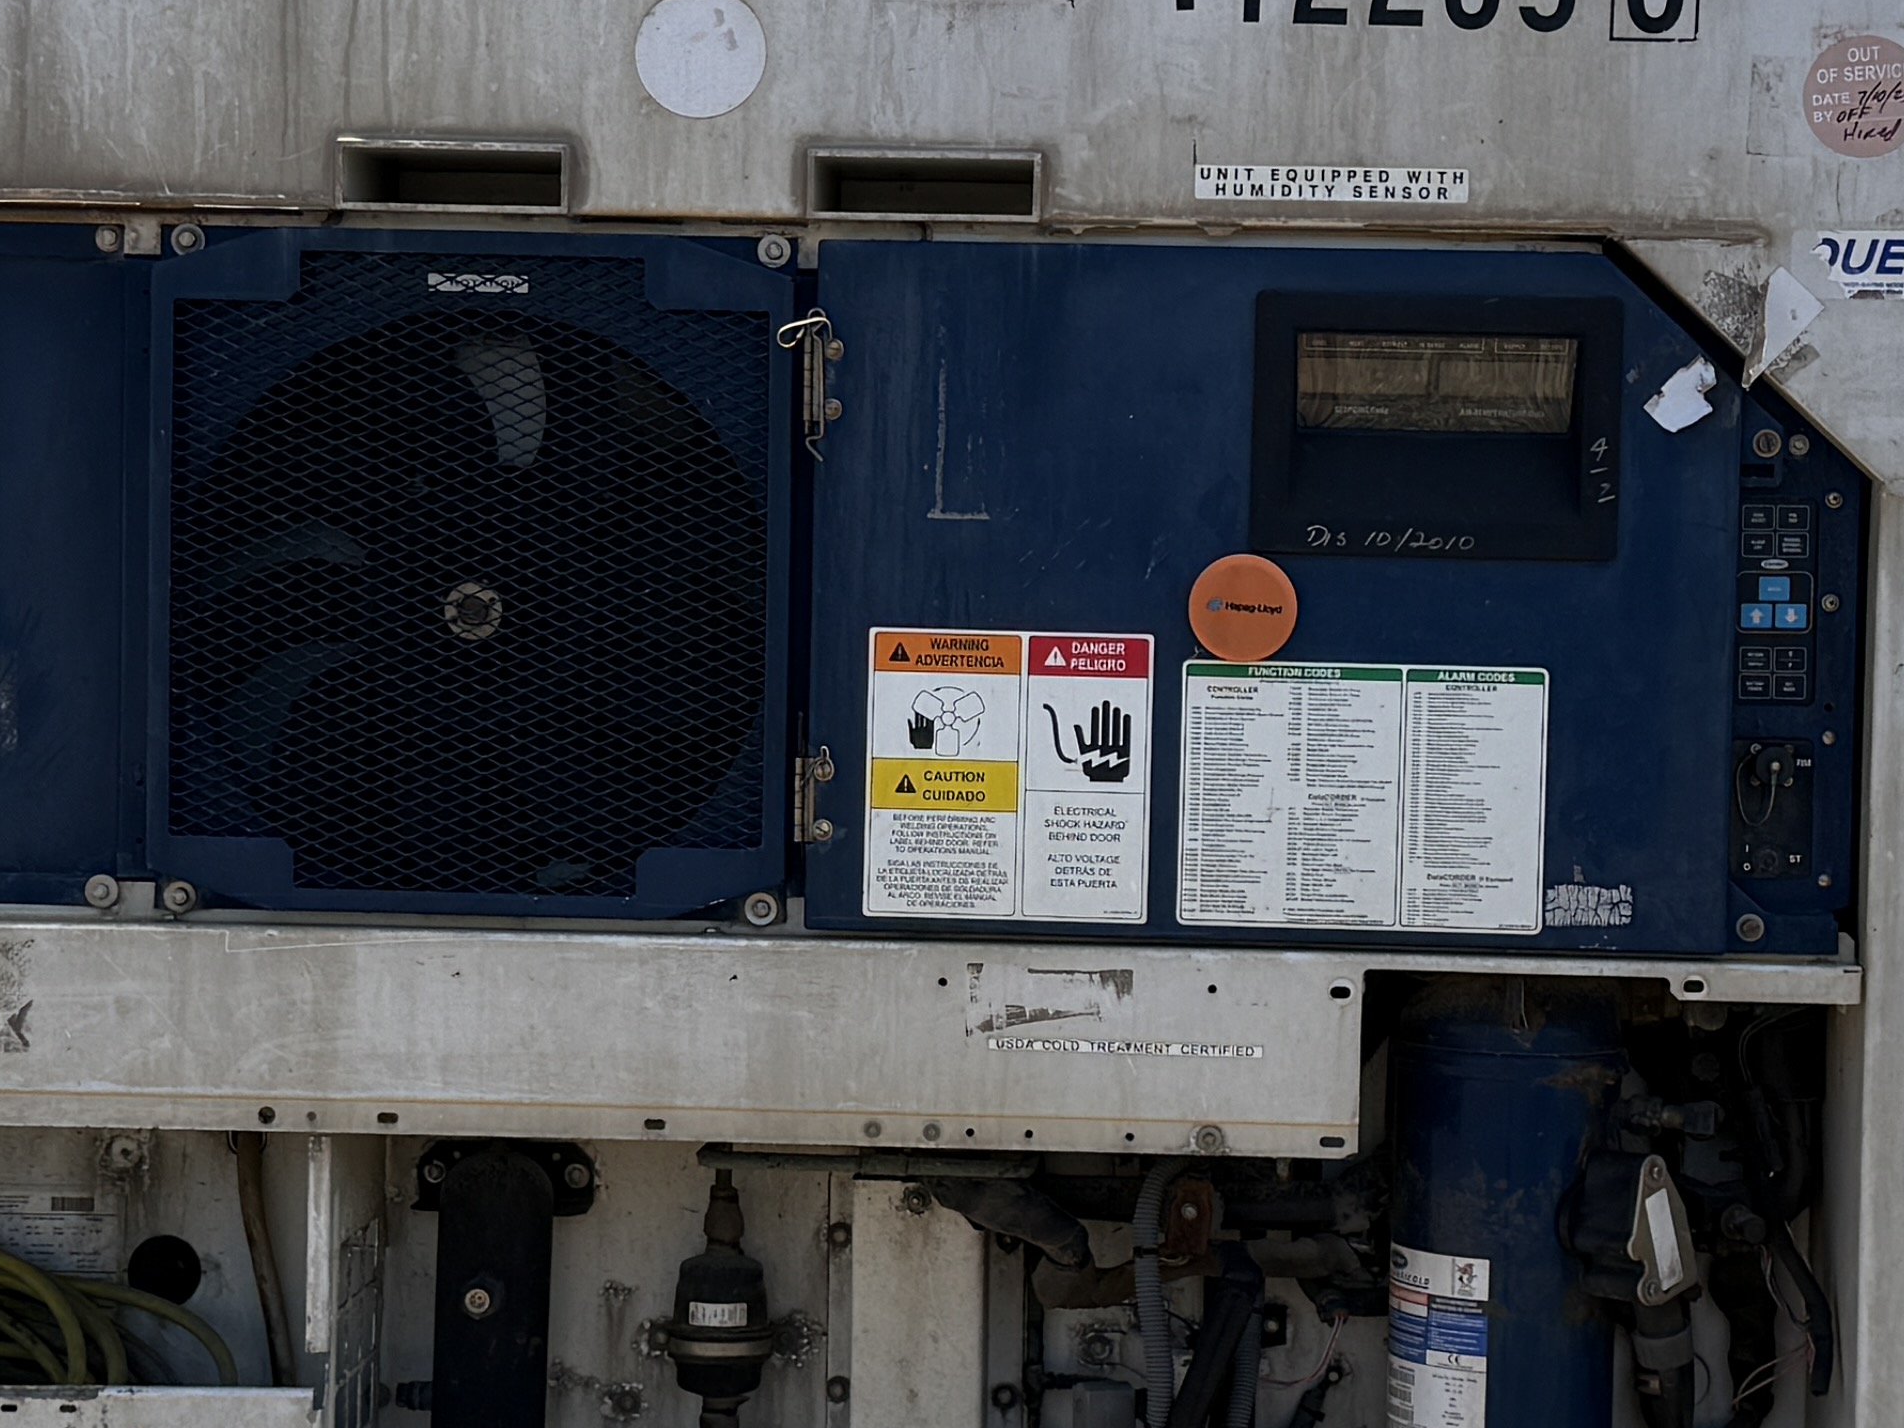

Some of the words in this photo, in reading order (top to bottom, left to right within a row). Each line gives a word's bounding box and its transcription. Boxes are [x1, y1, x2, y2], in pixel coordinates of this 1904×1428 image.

[1847, 46, 1880, 62] OUT
[1816, 68, 1838, 84] OF
[1812, 92, 1851, 106] DATE
[1813, 111, 1833, 122] BY
[1200, 167, 1254, 181] UNIT
[1271, 168, 1390, 183] EQUIPPED
[1406, 170, 1464, 184] WITH
[1216, 183, 1336, 198] HUMIDITY
[1352, 185, 1448, 200] SENSOR
[1225, 601, 1282, 614] Hapag-Lloyd
[930, 638, 990, 652] WARNING
[1072, 642, 1125, 655] DANGER
[915, 654, 1004, 669] ADVERTENCIA
[1070, 658, 1126, 672] PELIGRO
[1248, 667, 1302, 677] FUNCTION
[1303, 668, 1341, 678] CODES
[1437, 671, 1476, 681] ALARM
[1477, 672, 1515, 682] CODES
[1207, 685, 1259, 693] CONTROLLER
[923, 770, 985, 783] CAUTION
[923, 789, 986, 803] CUIDADO
[893, 813, 924, 821] BEFORE
[1054, 806, 1117, 817] ELECTRICAL
[1044, 819, 1080, 828] SHOCK
[1084, 820, 1126, 830] HAZARD
[926, 830, 983, 839] INSTRUCTIONS
[1049, 832, 1087, 841] BEHIND
[1090, 833, 1121, 842] DOOR
[915, 838, 944, 846] BEHIND
[907, 846, 957, 854] OPERATIONS
[1047, 854, 1073, 863] ALTO
[1098, 867, 1112, 876] DE
[1050, 878, 1075, 887] ESTA
[1077, 879, 1117, 889] PUERTA
[996, 1038, 1034, 1051] USDA
[1042, 1039, 1080, 1051] COLD
[1090, 1041, 1172, 1055] TREATMENT
[1181, 1044, 1255, 1057] CERTIFIED
